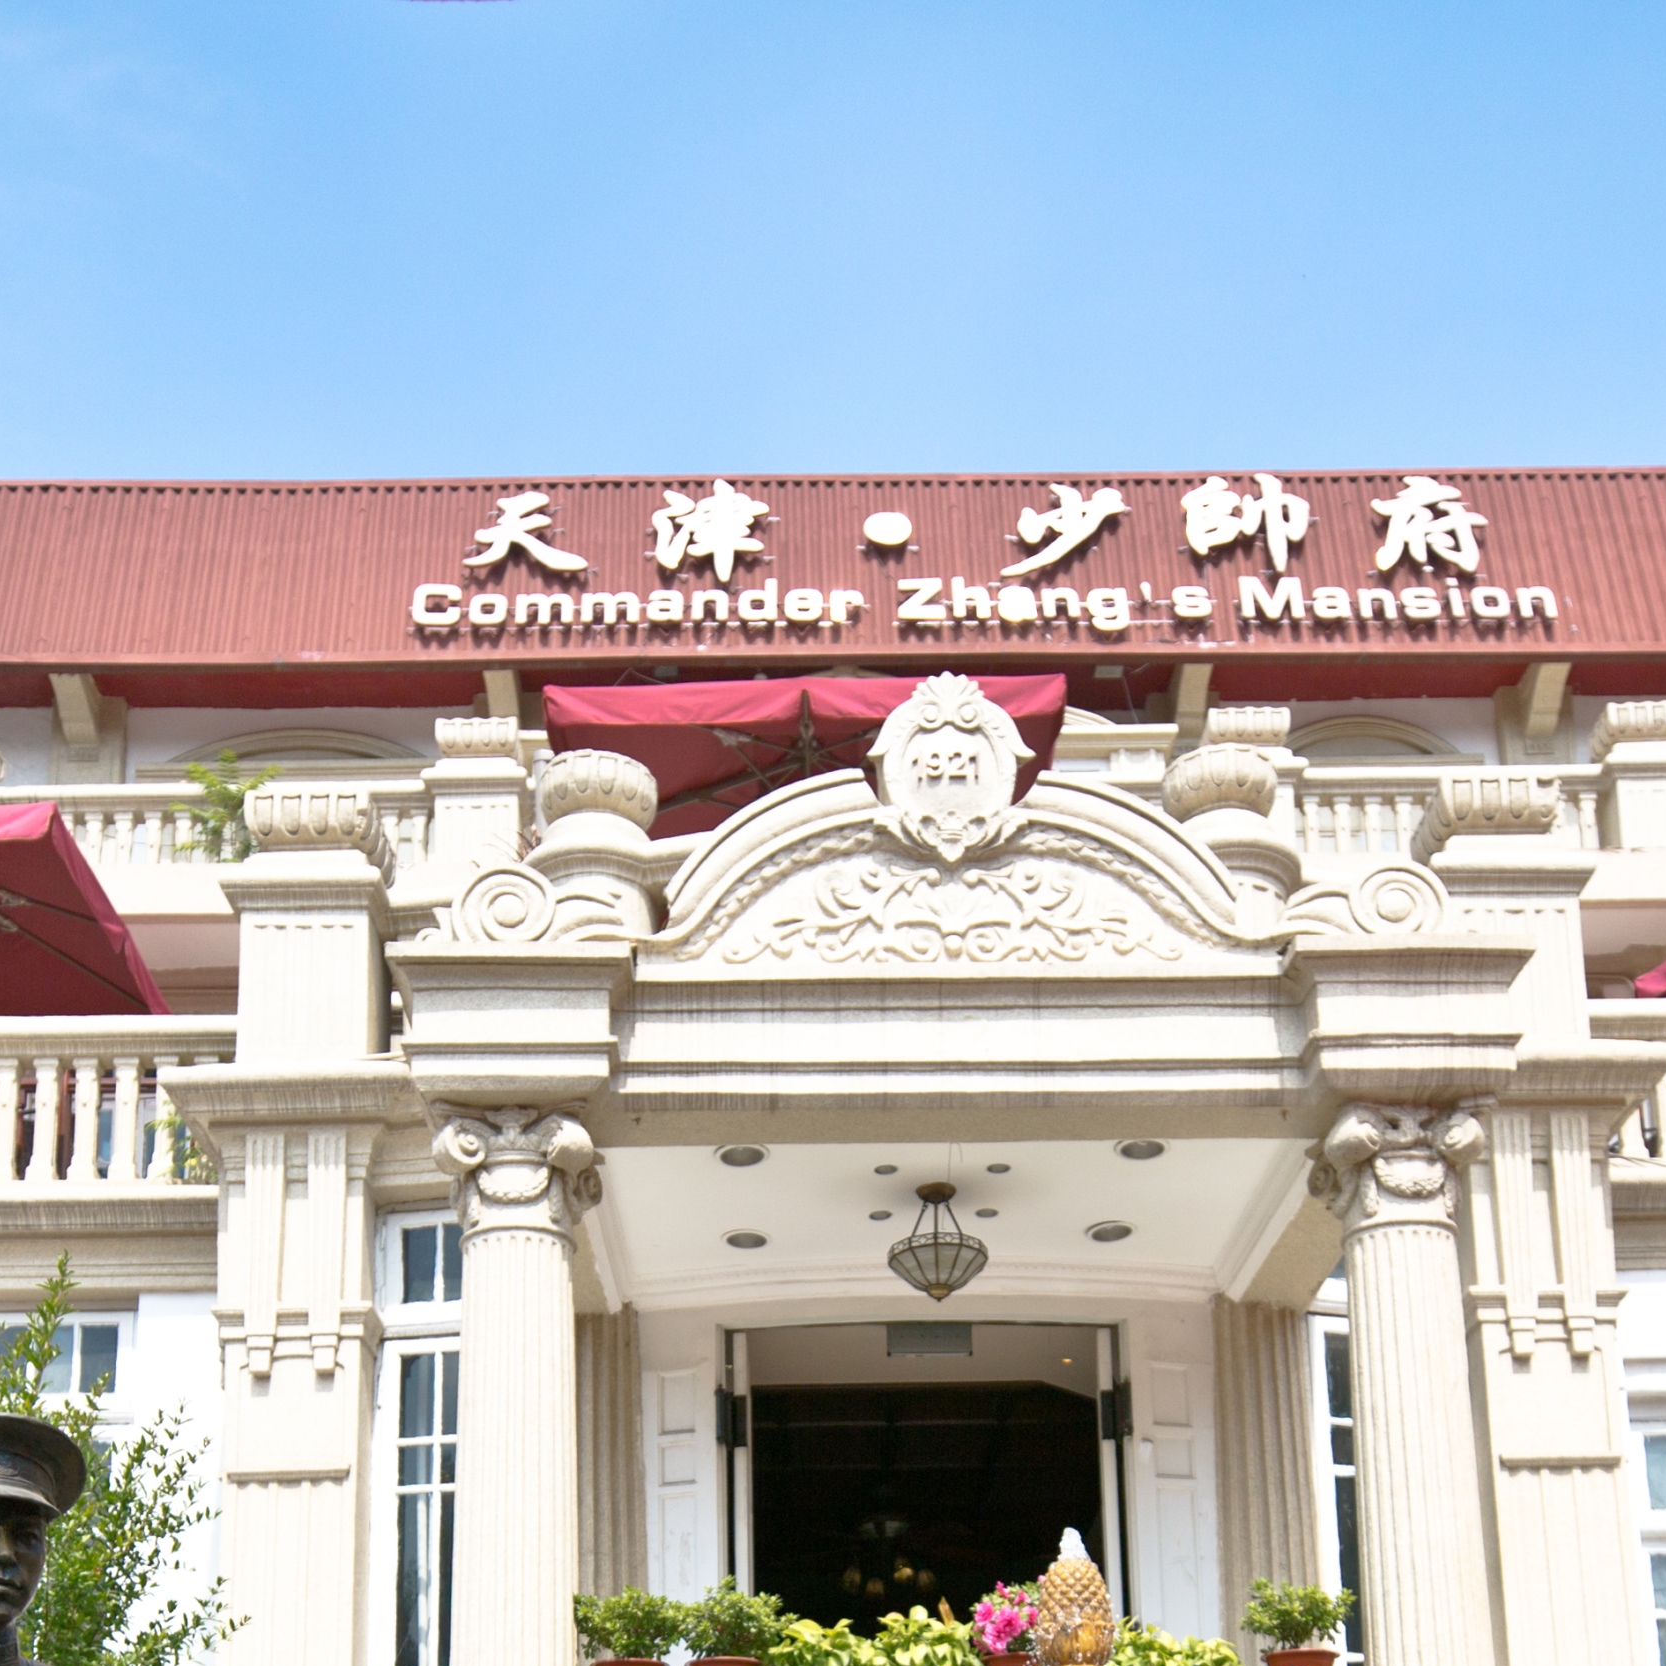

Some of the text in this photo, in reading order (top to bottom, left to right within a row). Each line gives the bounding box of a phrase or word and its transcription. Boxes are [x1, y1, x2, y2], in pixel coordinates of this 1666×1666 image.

[411, 575, 1559, 632] Commander Zhang's Mansion
[909, 750, 981, 782] 1921
